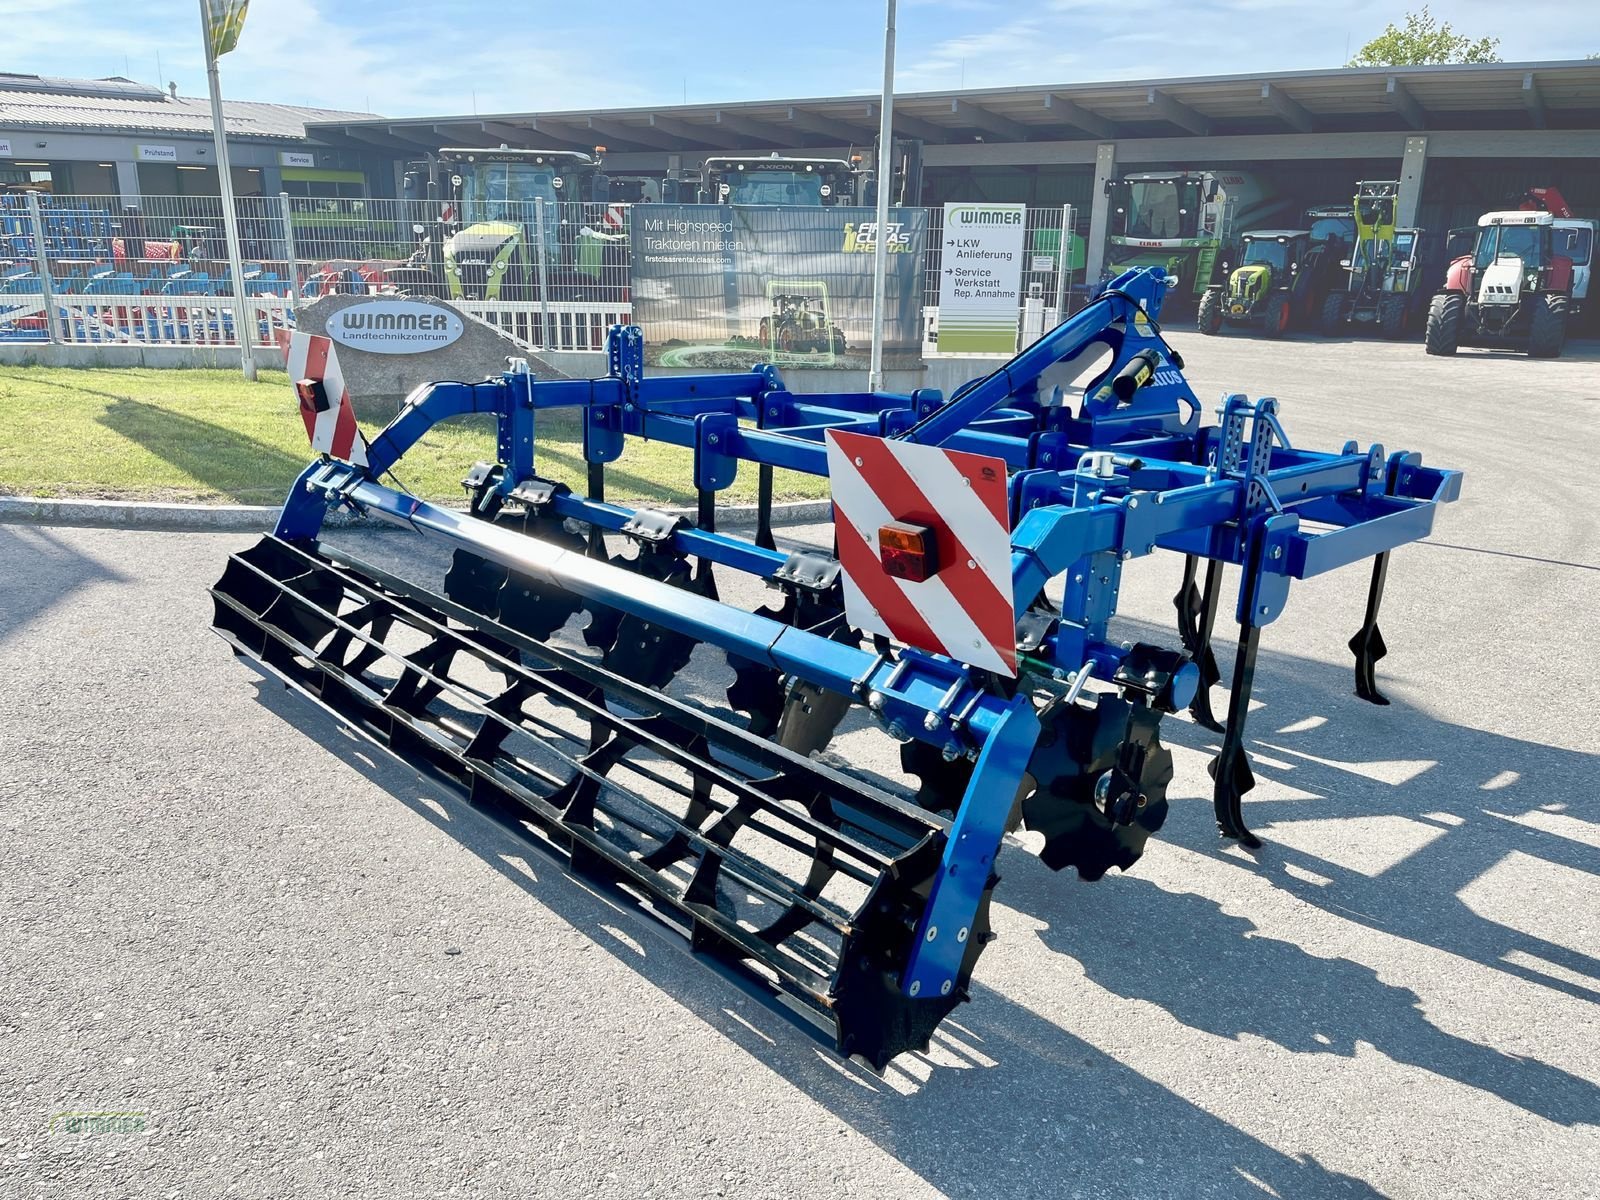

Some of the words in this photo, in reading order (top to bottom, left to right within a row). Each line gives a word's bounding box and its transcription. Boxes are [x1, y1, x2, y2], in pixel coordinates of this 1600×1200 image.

[960, 211, 1022, 225] WIMMER
[645, 219, 663, 232] Mit
[667, 219, 733, 234] Highspeed
[856, 233, 910, 243] CLAS
[645, 237, 700, 250] Traktoren
[703, 240, 747, 251] mieten.
[853, 243, 913, 253] RETAL
[957, 239, 980, 248] LKW
[956, 250, 1013, 261] Anlieferung
[955, 268, 991, 277] Service
[955, 278, 1000, 287] Werkstatt
[953, 289, 973, 300] Rep.
[975, 289, 1016, 298] Annahme
[343, 313, 447, 331] WIMMER
[343, 331, 448, 341] Landtechnikzentrum
